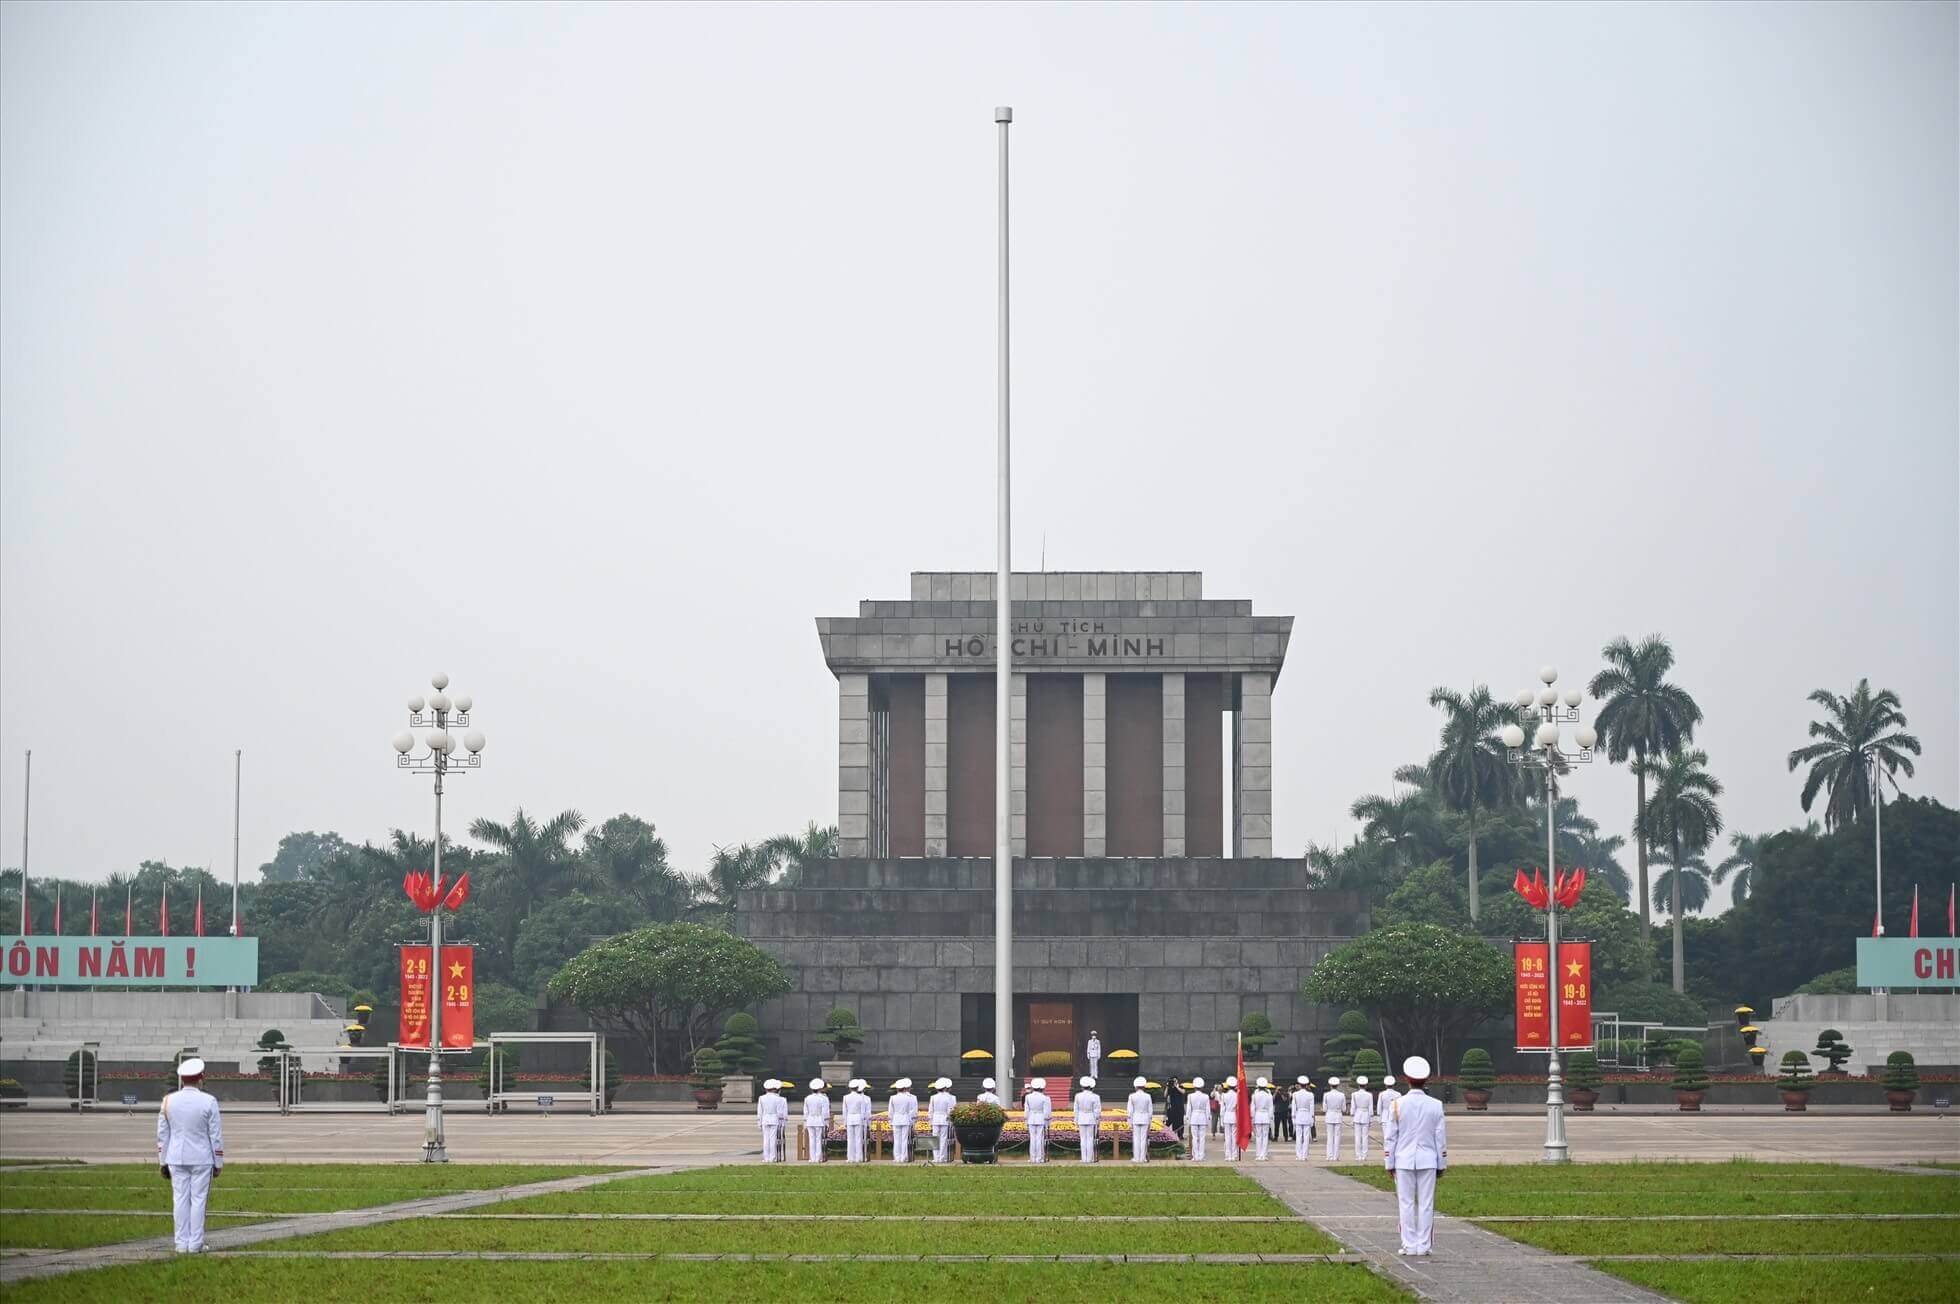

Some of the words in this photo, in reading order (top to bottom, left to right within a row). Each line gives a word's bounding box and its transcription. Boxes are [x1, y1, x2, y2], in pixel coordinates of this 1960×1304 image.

[1011, 618, 1044, 633] HỦ
[0, 940, 59, 977] ÔN
[78, 940, 165, 977] NĂM
[1521, 957, 1543, 971] 19-8
[1914, 948, 1960, 979] CH
[447, 985, 468, 1001] 2-9
[1564, 983, 1586, 999] 19-8
